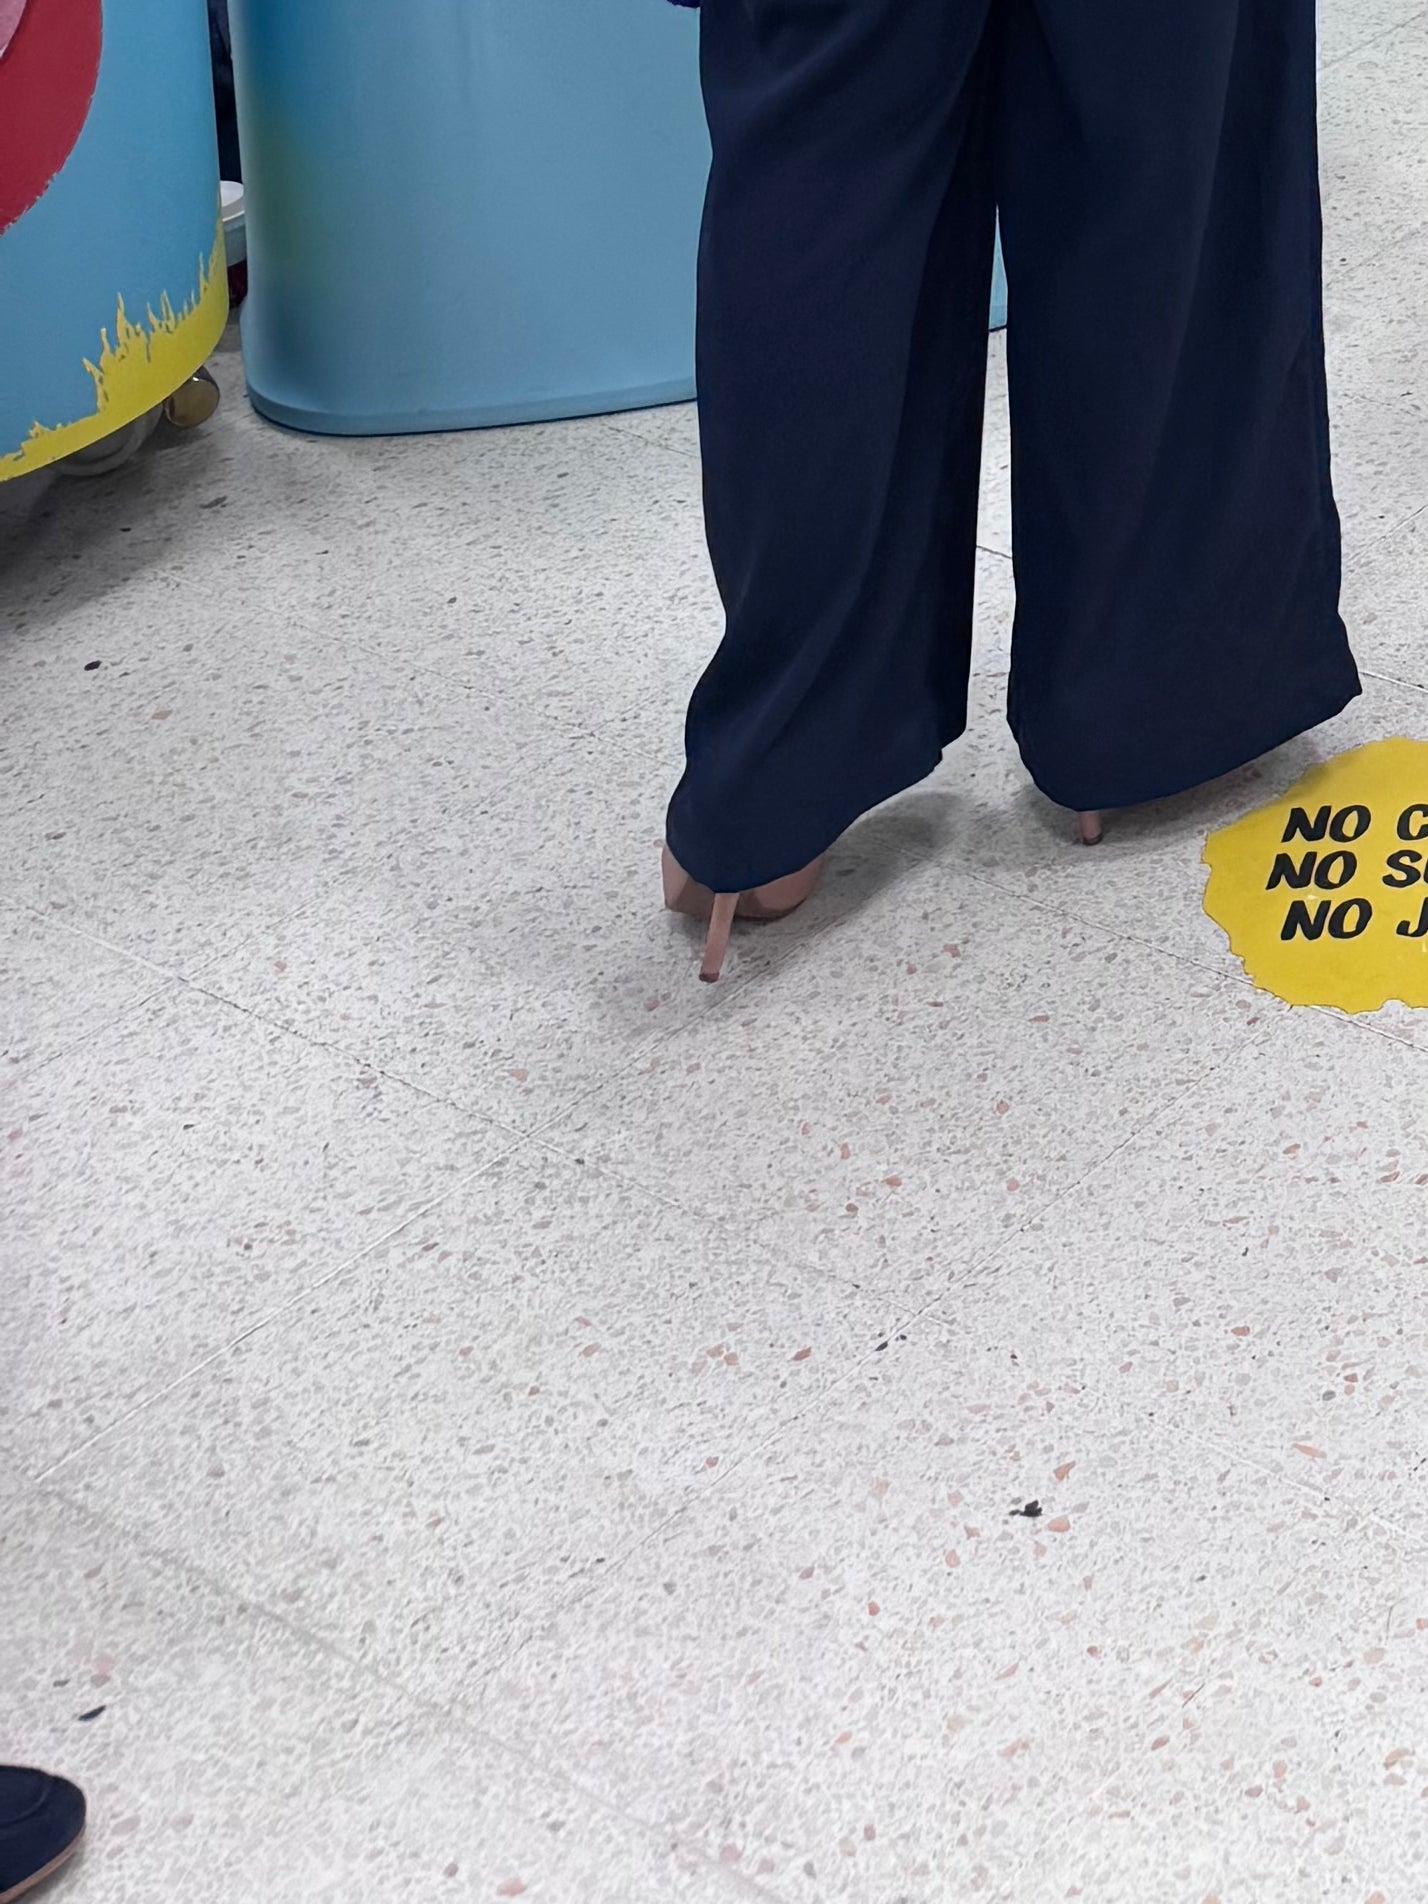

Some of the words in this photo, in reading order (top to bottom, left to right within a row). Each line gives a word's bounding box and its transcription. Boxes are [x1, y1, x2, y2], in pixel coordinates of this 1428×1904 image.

[1281, 804, 1371, 843] NO
[1266, 850, 1358, 890] NO
[1280, 897, 1372, 941] NO
